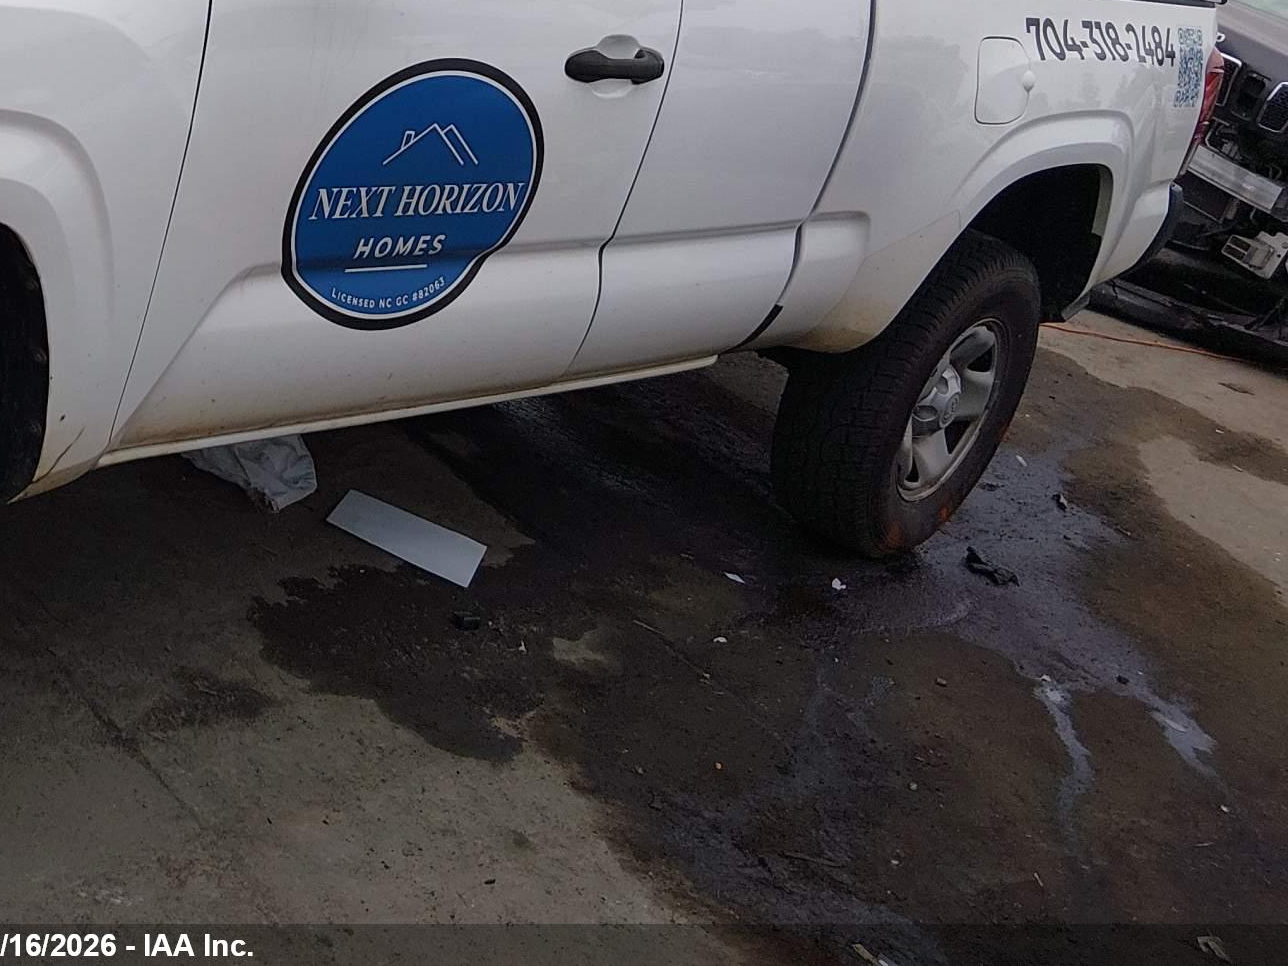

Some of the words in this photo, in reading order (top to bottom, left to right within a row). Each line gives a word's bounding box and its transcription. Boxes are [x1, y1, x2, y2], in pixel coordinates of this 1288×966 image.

[1025, 17, 1177, 67] 704-318-2484
[308, 186, 396, 221] NEXT
[394, 182, 525, 218] HORIZON
[353, 234, 447, 260] HOMES
[379, 297, 392, 309] NC
[395, 295, 409, 307] GC
